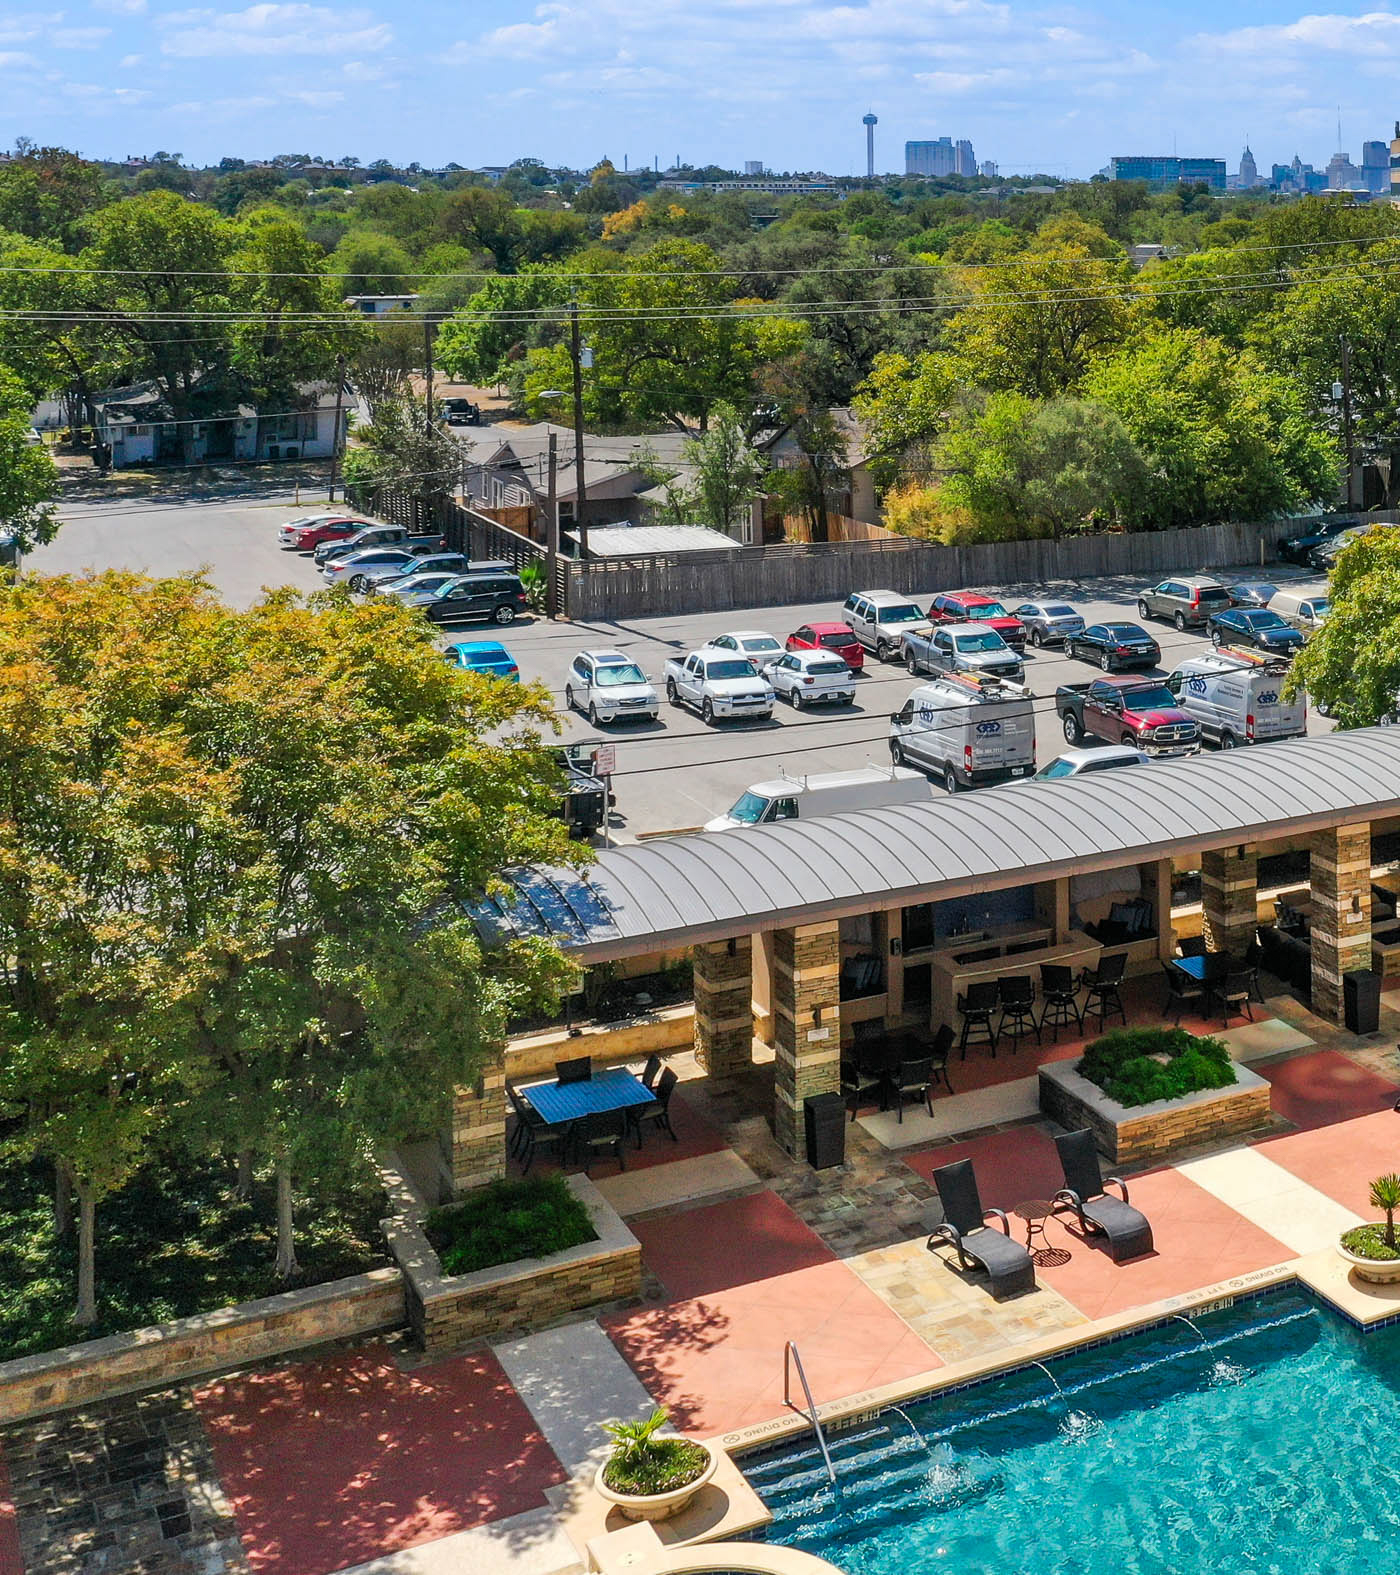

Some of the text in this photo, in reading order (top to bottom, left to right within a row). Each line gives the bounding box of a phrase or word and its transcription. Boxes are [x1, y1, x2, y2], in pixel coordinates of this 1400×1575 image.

[1223, 1297, 1233, 1309] IN
[867, 1408, 880, 1420] IN
[743, 1416, 799, 1438] NO DIVING
